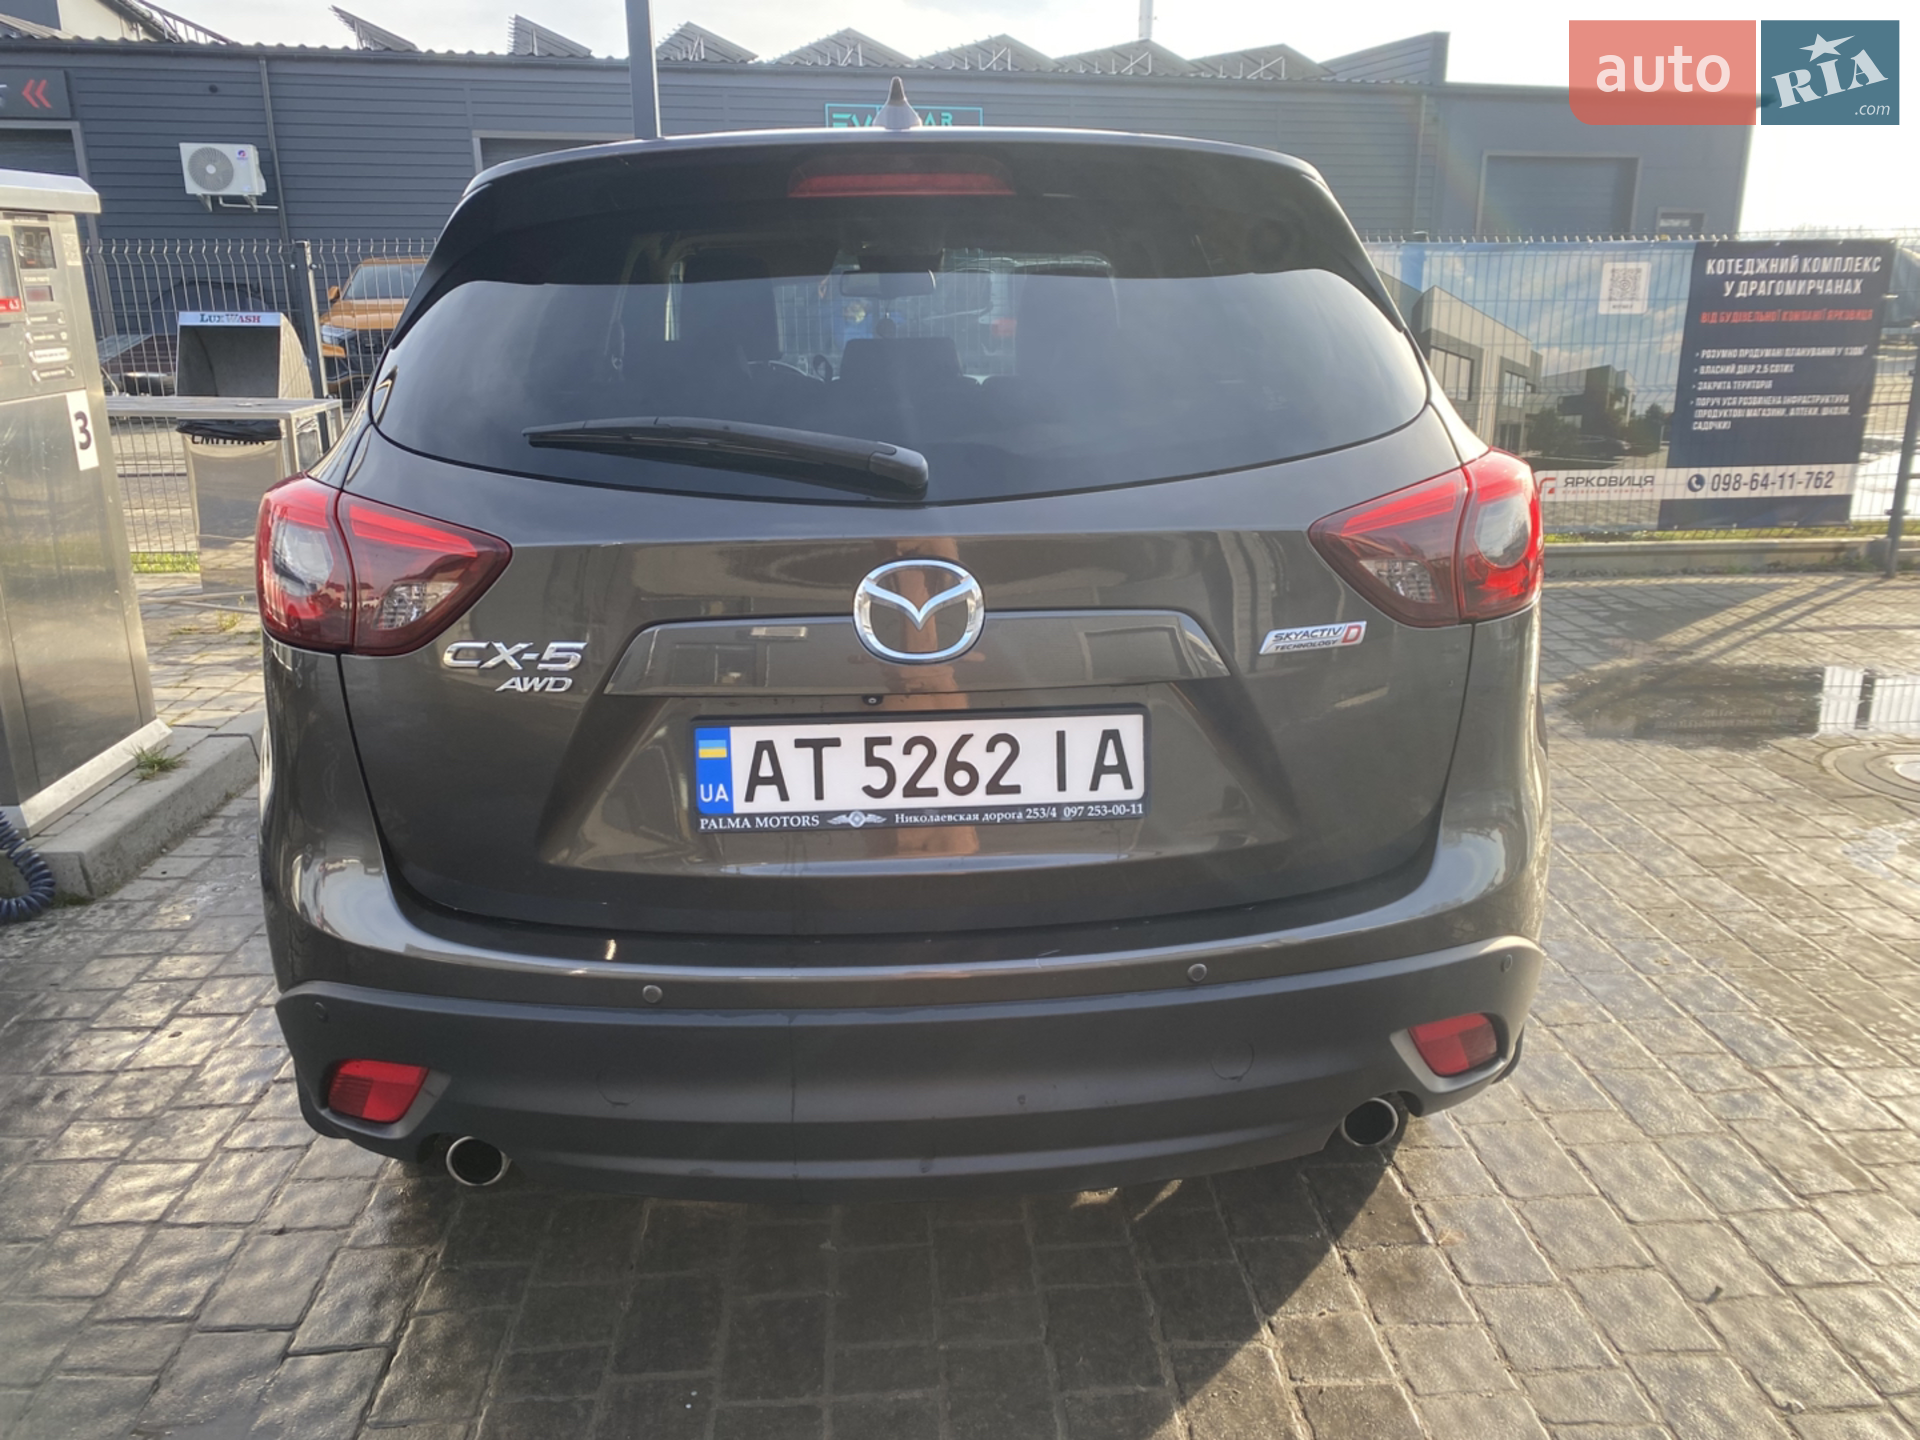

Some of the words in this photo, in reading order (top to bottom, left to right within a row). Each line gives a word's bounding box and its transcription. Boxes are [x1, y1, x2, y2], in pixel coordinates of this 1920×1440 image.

[1706, 255, 1799, 276] КОТЕДЖНИЙ
[1801, 256, 1882, 273] КОМПЛЕКС
[1723, 280, 1735, 297] У
[1735, 278, 1864, 298] ДРАГОМИРЧАНАХ
[1701, 311, 1718, 324] ВІД
[1719, 309, 1781, 323] БУДІВЕЛЬНОЇ
[1782, 309, 1826, 322] КОМПАНІЇ
[1827, 309, 1873, 321] ЯРКОВИЦЯ
[1701, 348, 1738, 359] РОЗУМНО
[1699, 363, 1736, 375] ВЛАСНИЙ
[1770, 363, 1795, 374] СОТИХ
[1697, 380, 1731, 391] ЗАКРИТА
[1732, 379, 1773, 390] ТЕРИТОРІЯ
[74, 410, 92, 450] 3
[1564, 475, 1655, 488] ЯРКОВИЦЯ
[1711, 470, 1836, 492] 098-64-11-762
[1272, 626, 1342, 642] SKYACTIV
[1275, 639, 1339, 651] TECHNOLOGY
[443, 640, 588, 671] CX-5
[495, 676, 573, 693] AWD
[744, 737, 841, 803] AT
[862, 732, 1021, 799] 5262
[1056, 729, 1133, 792] IA
[700, 783, 729, 803] UA
[700, 817, 751, 829] PALMA
[755, 815, 820, 828] MOTORS
[895, 811, 979, 824] Николаевская
[982, 811, 1023, 824] дорога
[1025, 806, 1057, 820] 253/4
[1063, 805, 1084, 818] 097
[1087, 803, 1144, 817] 253-00-11
